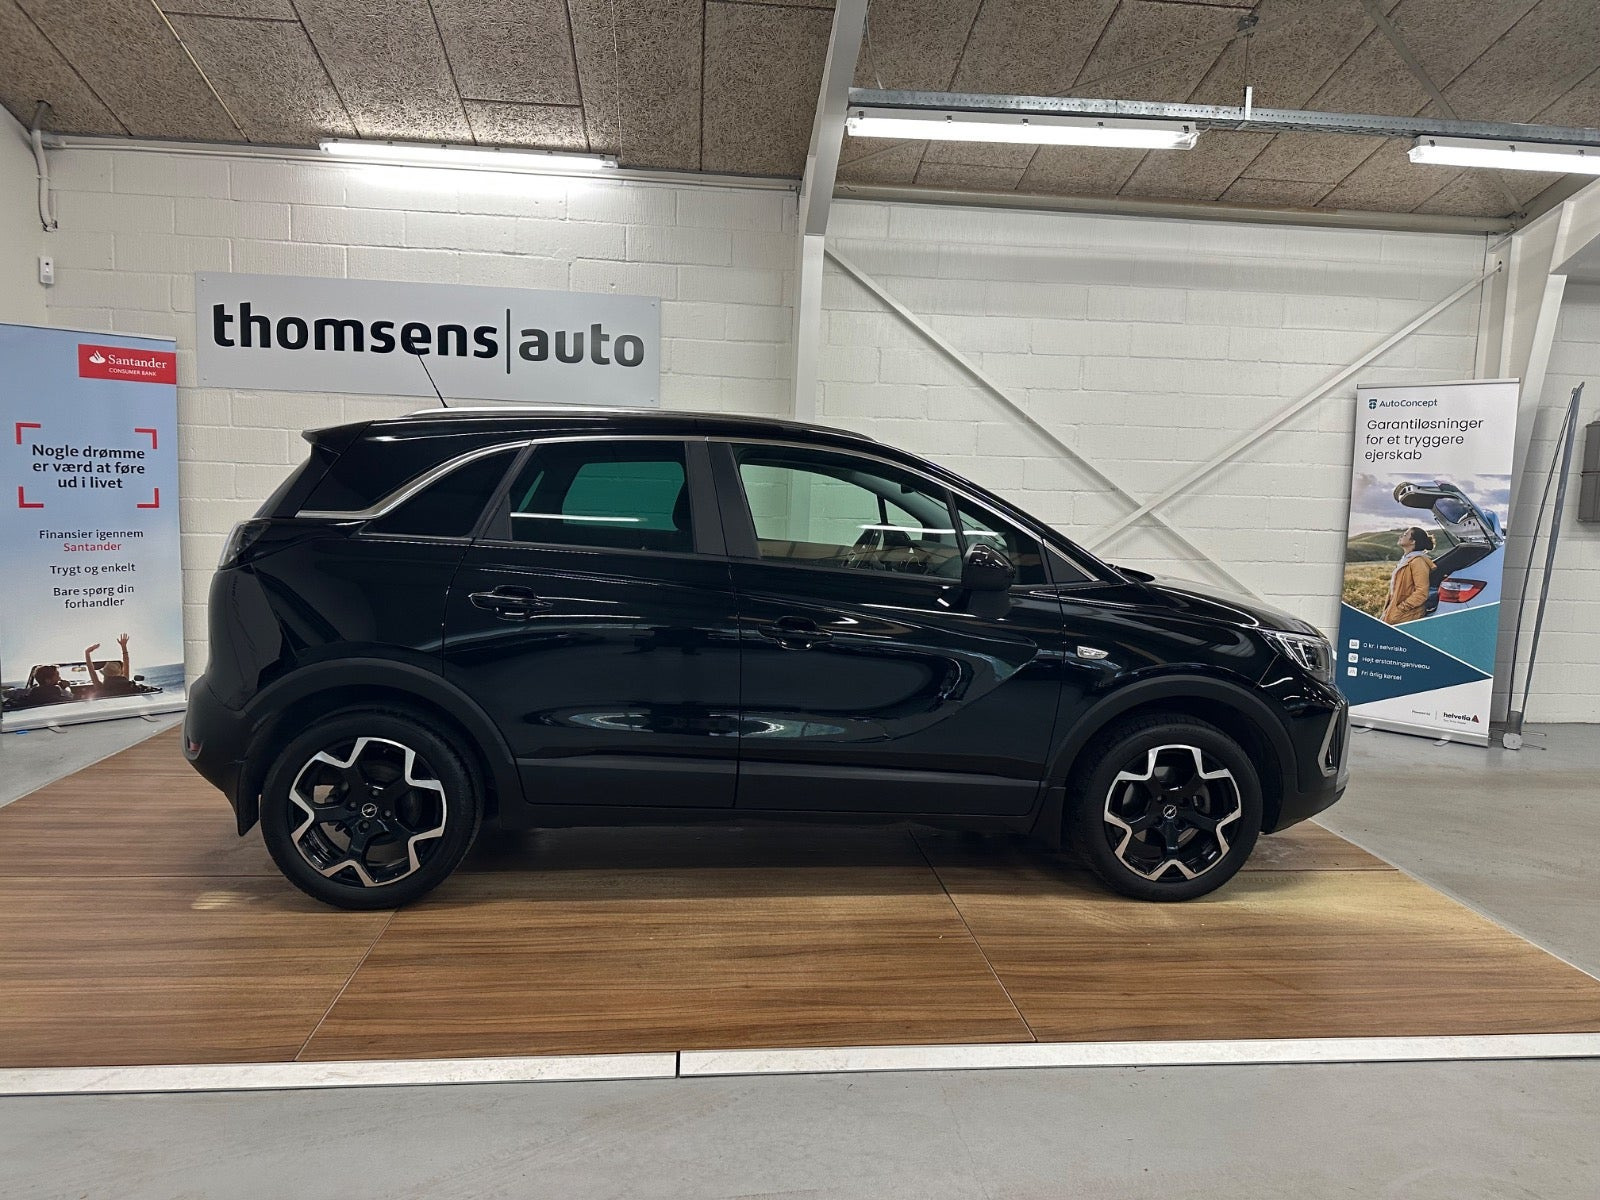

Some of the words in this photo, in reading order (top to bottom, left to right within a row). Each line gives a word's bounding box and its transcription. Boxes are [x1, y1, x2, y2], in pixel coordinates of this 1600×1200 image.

[213, 301, 498, 359] thomsens
[518, 323, 645, 368] auto
[108, 354, 167, 369] Santander
[1379, 398, 1438, 408] AutoConcept
[1367, 418, 1484, 431] Garantiløsninger
[1366, 434, 1383, 445] for
[1387, 435, 1400, 445] et
[1404, 434, 1464, 447] tryggere
[32, 444, 79, 459] Nogle
[83, 445, 145, 459] drømme
[1364, 449, 1422, 463] ejerskab
[32, 462, 48, 472] er
[53, 461, 93, 473] værd
[96, 463, 111, 473] at
[115, 461, 145, 474] føre
[58, 477, 77, 488] ud
[82, 477, 86, 488] i
[90, 477, 123, 489] livet
[39, 529, 93, 539] Finansier
[96, 528, 144, 540] igennem
[63, 542, 122, 552] Santander
[50, 565, 81, 576] Trygt
[84, 565, 99, 575] og
[101, 562, 136, 573] enkelt
[53, 587, 80, 597] Bare
[82, 586, 115, 597] spørg
[117, 584, 135, 593] din
[65, 598, 125, 609] forhandler
[1369, 670, 1383, 679] årlig
[1443, 712, 1471, 721] helvetia
